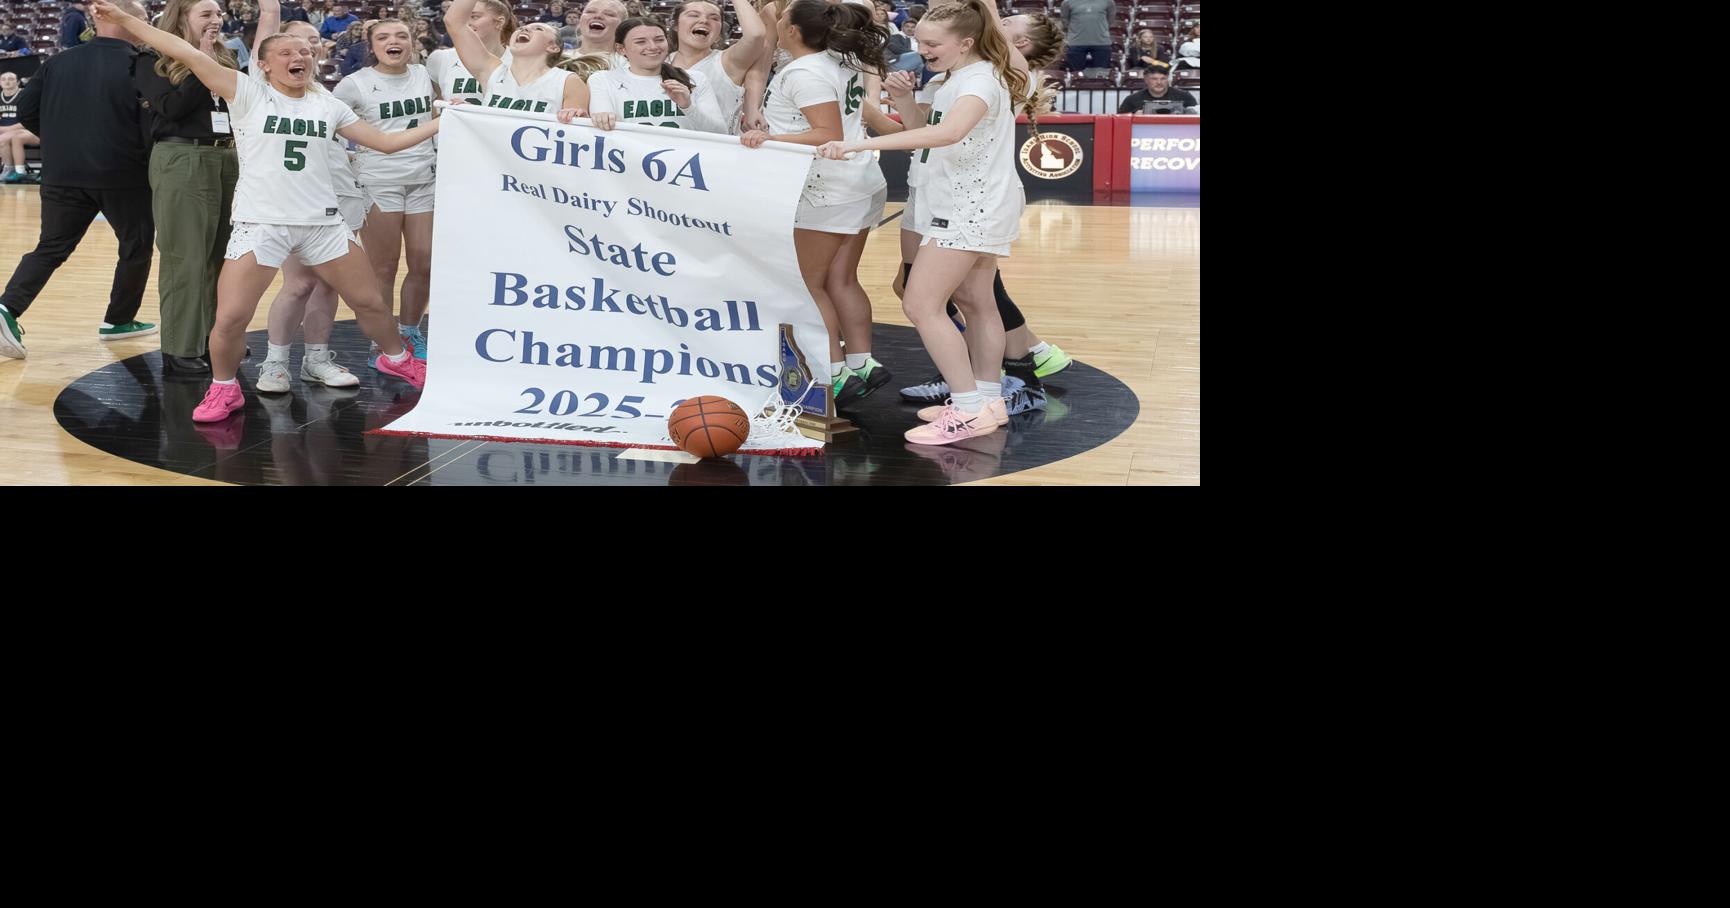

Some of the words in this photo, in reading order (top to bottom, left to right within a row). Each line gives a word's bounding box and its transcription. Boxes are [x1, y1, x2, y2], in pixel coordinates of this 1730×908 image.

[263, 115, 327, 138] EAGLE
[379, 95, 432, 120] EAGLE
[284, 140, 308, 171] 5
[510, 125, 626, 174] Girls
[641, 148, 710, 192] 6A
[501, 173, 547, 200] Real
[551, 186, 617, 218] Dairy
[627, 197, 733, 237] Shootout
[563, 224, 677, 277] State
[488, 271, 764, 331] Basketball
[474, 328, 779, 388] Champions
[513, 387, 687, 419] 2025-
